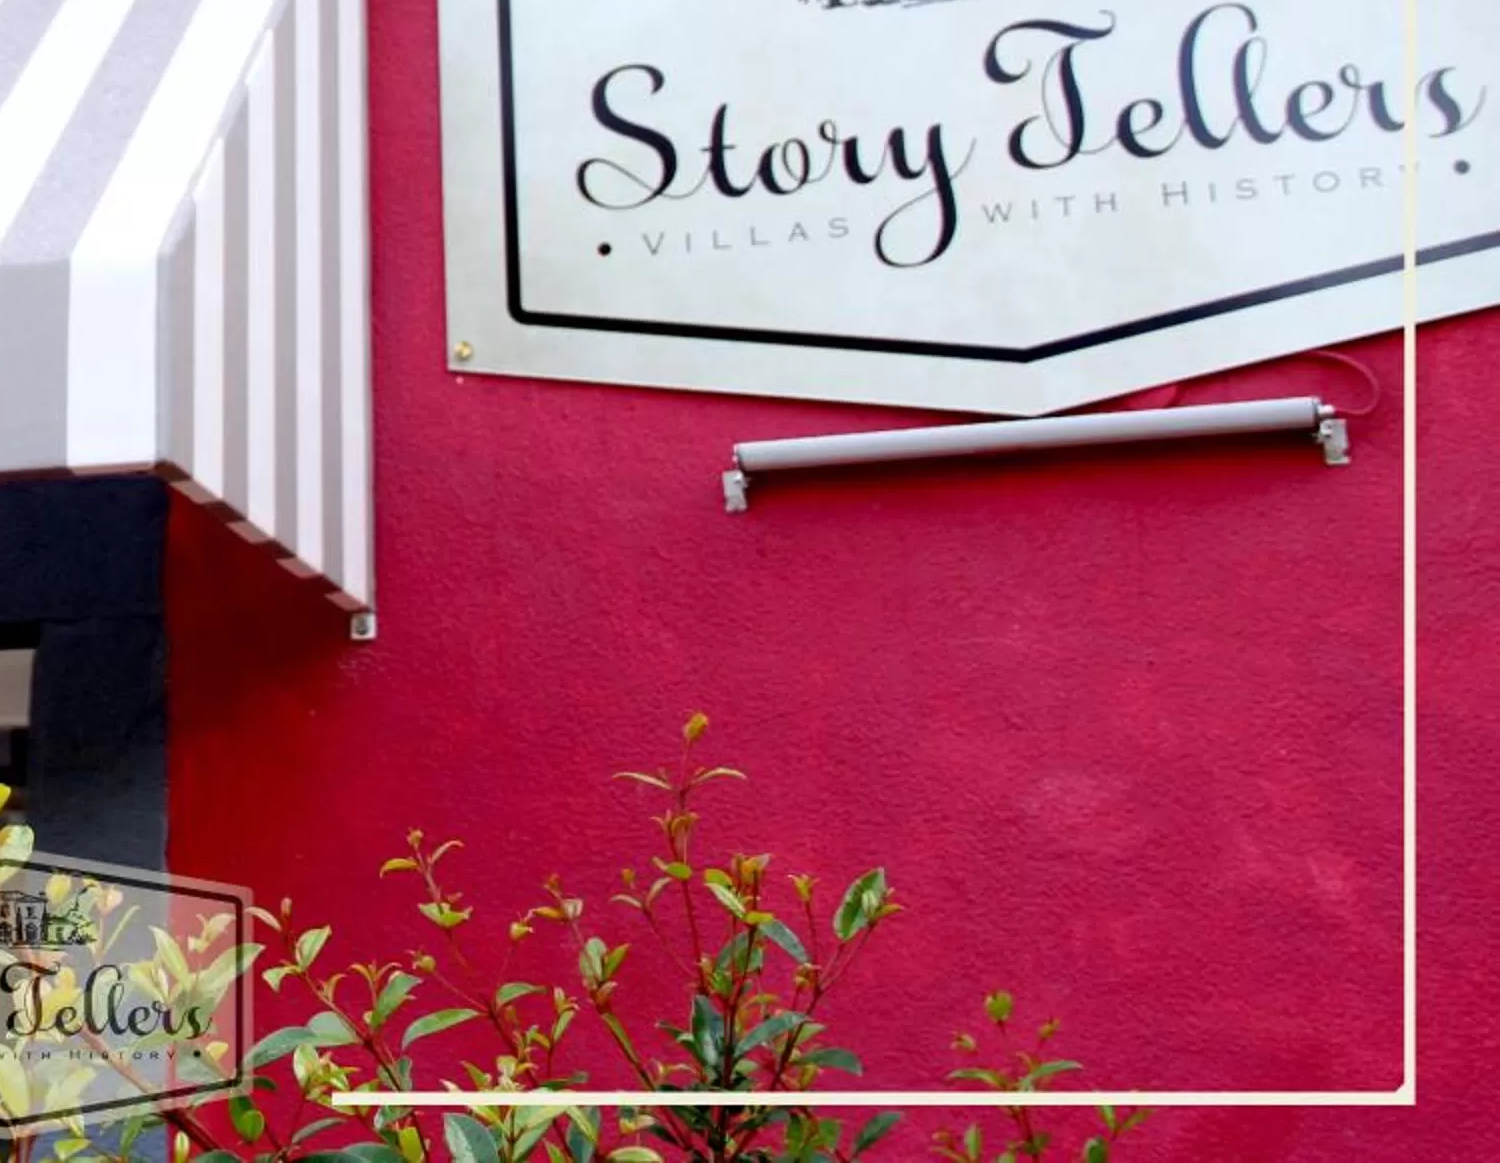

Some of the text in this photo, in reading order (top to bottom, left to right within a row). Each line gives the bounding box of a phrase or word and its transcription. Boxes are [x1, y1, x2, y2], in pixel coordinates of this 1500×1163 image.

[575, 1, 1487, 268] Story Tellers
[641, 216, 851, 256] VILLAS
[981, 192, 1119, 225] WITH
